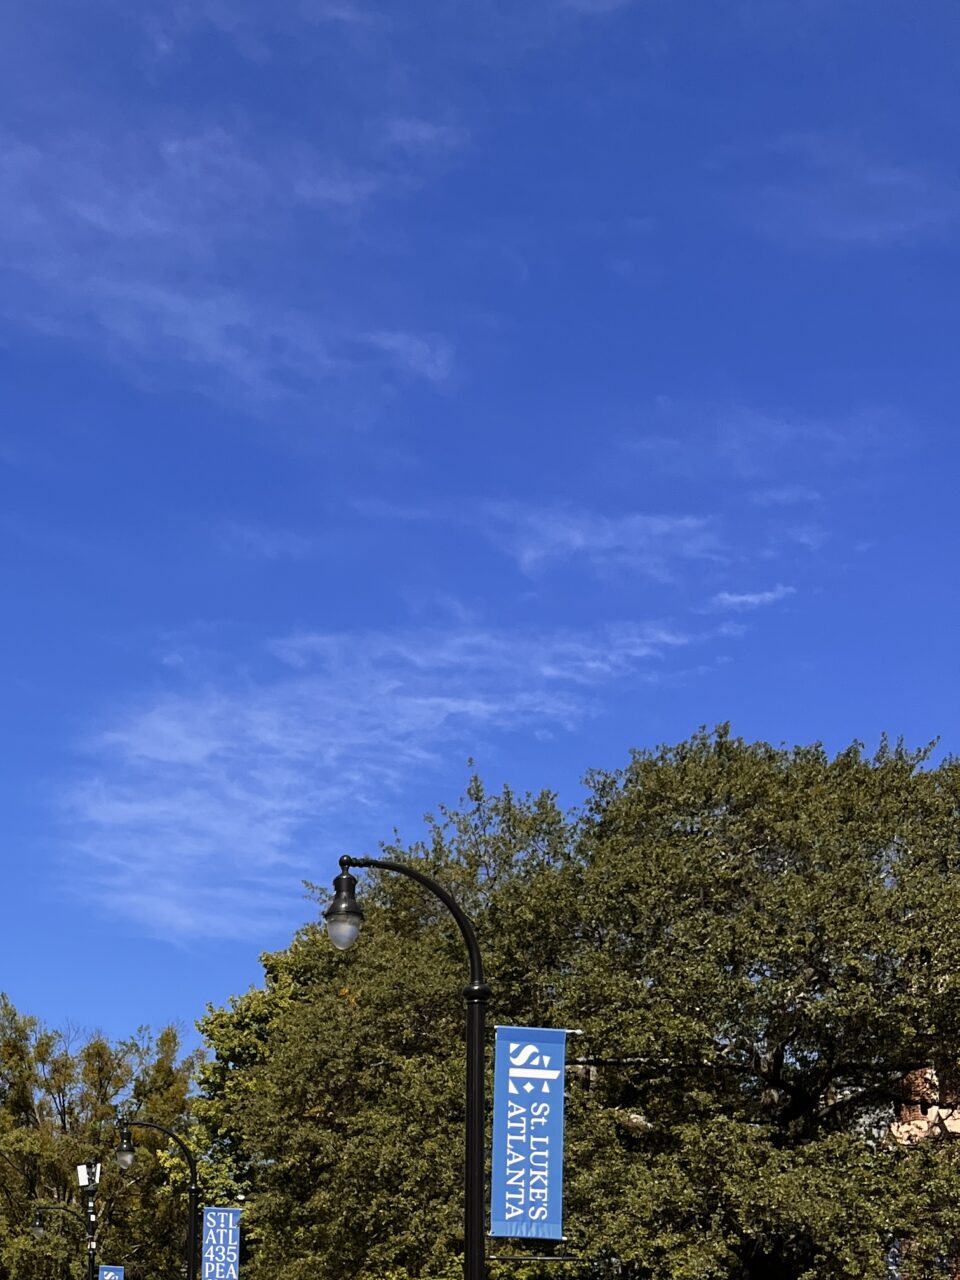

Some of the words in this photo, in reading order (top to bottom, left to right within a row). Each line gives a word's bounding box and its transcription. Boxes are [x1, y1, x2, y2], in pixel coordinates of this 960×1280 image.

[531, 1102, 550, 1131] St.
[505, 1100, 526, 1220] ATLANTA
[529, 1136, 549, 1221] LUKE'S
[205, 1229, 237, 1245] ATL
[204, 1245, 237, 1262] 435
[205, 1262, 237, 1279] PEA
